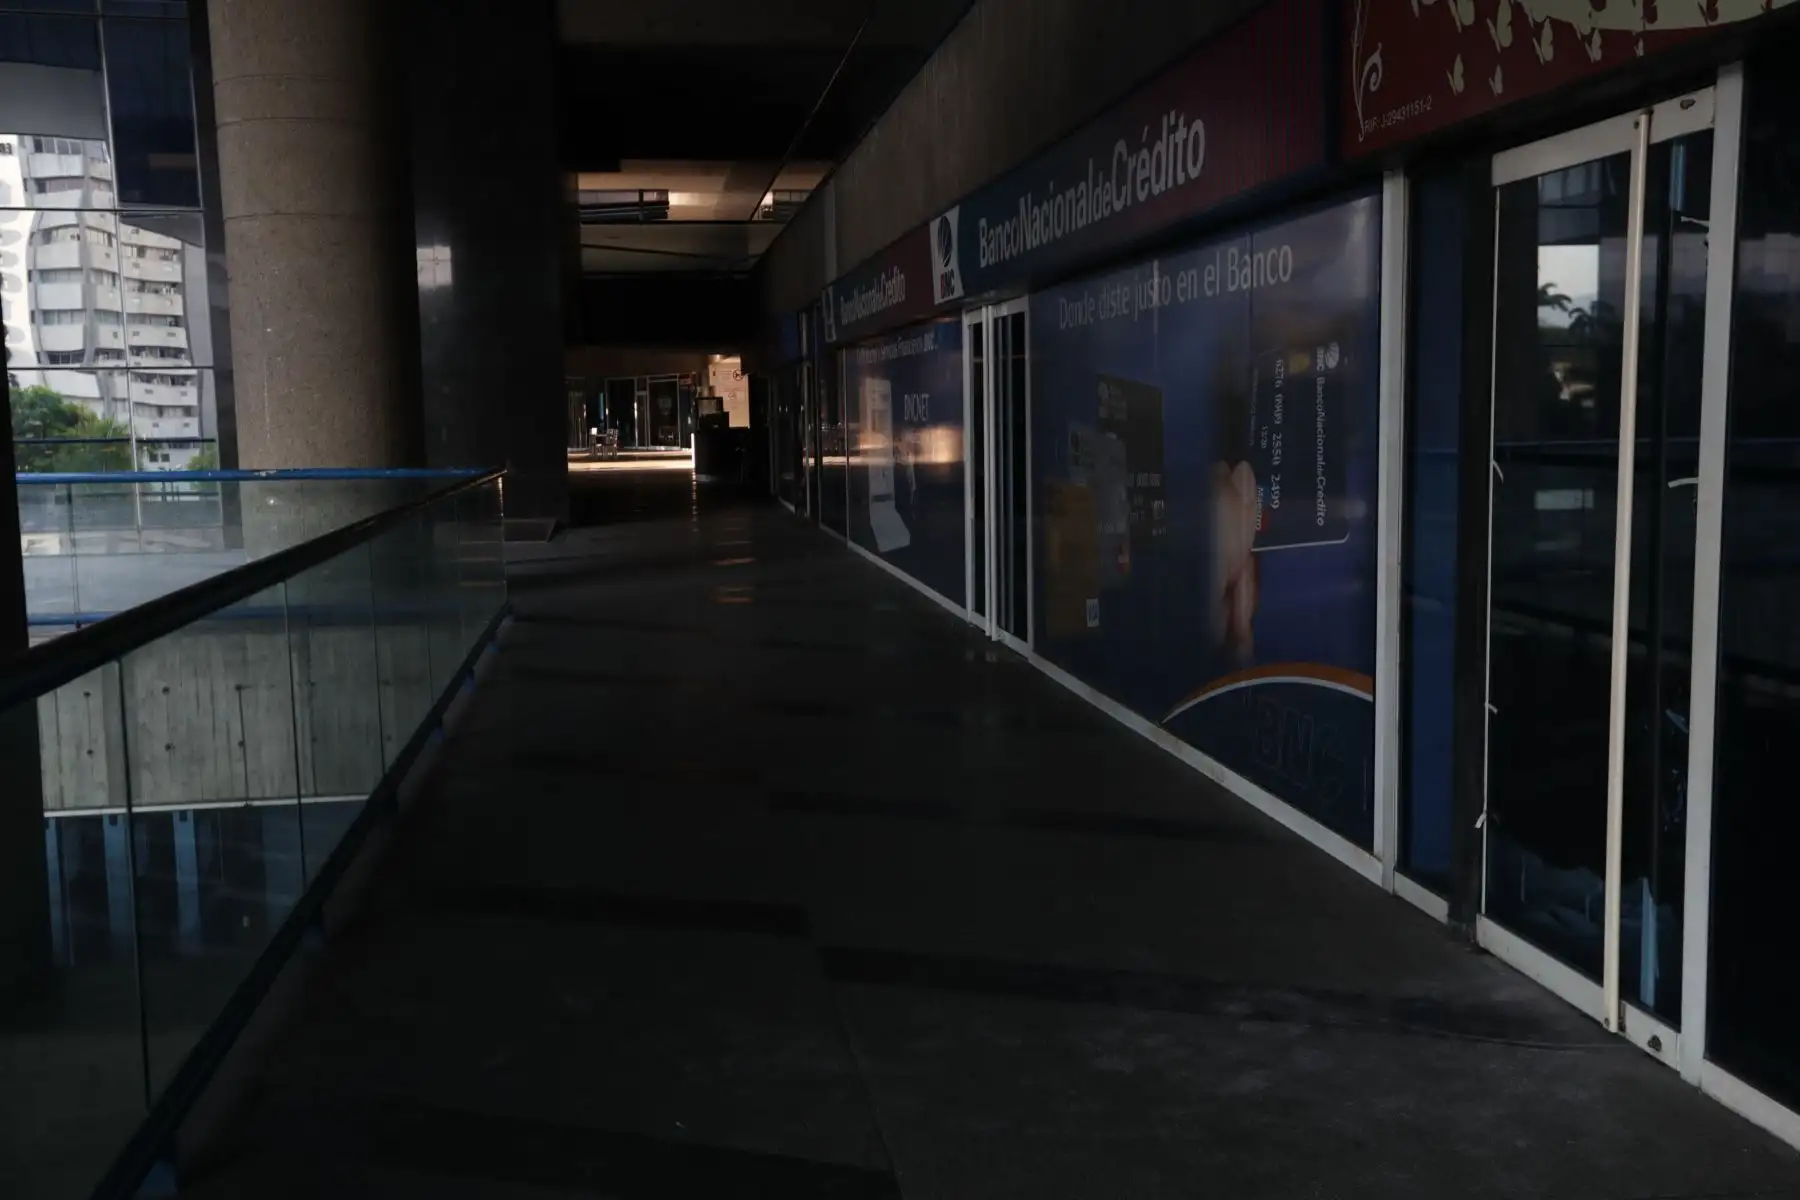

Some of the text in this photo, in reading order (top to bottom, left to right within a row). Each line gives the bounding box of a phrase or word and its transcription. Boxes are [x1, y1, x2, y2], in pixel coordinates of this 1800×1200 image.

[978, 108, 1206, 268] BancoNacionaldeCrédito
[1059, 244, 1293, 330] Donde diste justo en el Banco
